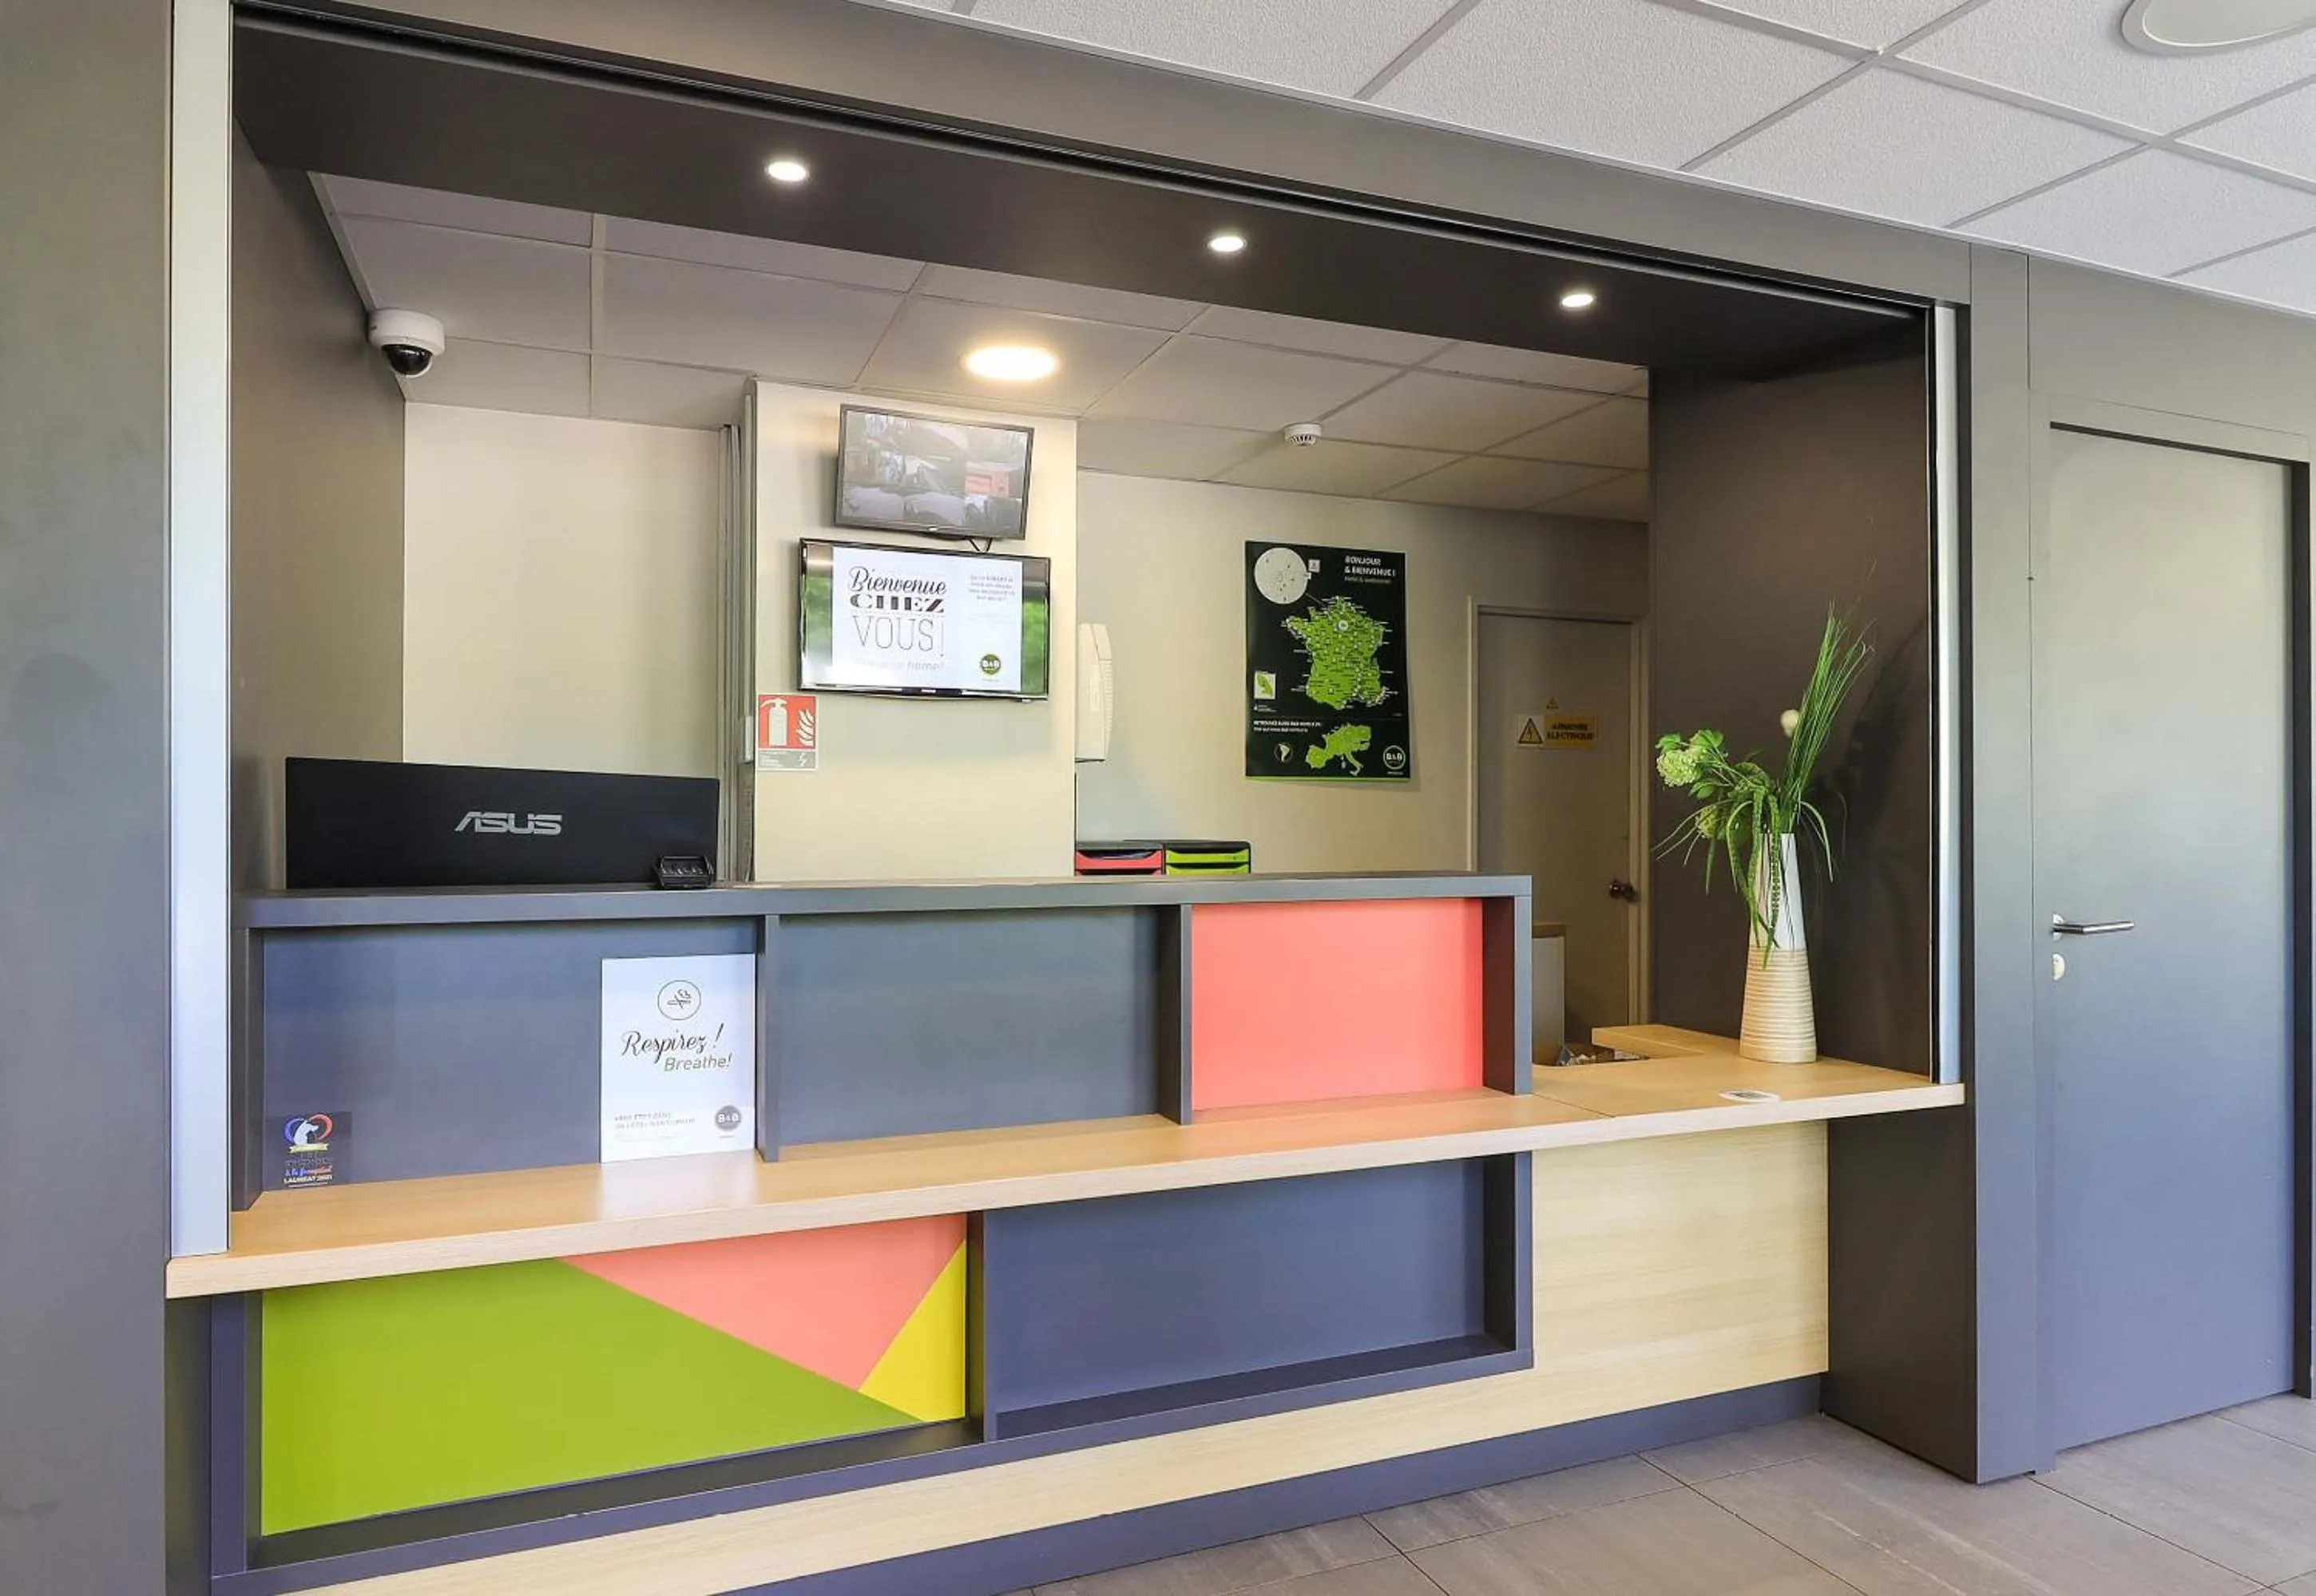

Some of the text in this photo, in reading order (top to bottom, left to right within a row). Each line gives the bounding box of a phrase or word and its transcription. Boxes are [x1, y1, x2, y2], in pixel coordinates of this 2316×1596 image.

[848, 565, 947, 596] Bienvenue
[850, 593, 944, 613] CHEZ
[454, 811, 563, 835] ASUS
[621, 1028, 708, 1064] Respirez
[663, 1052, 733, 1072] Breathe!
